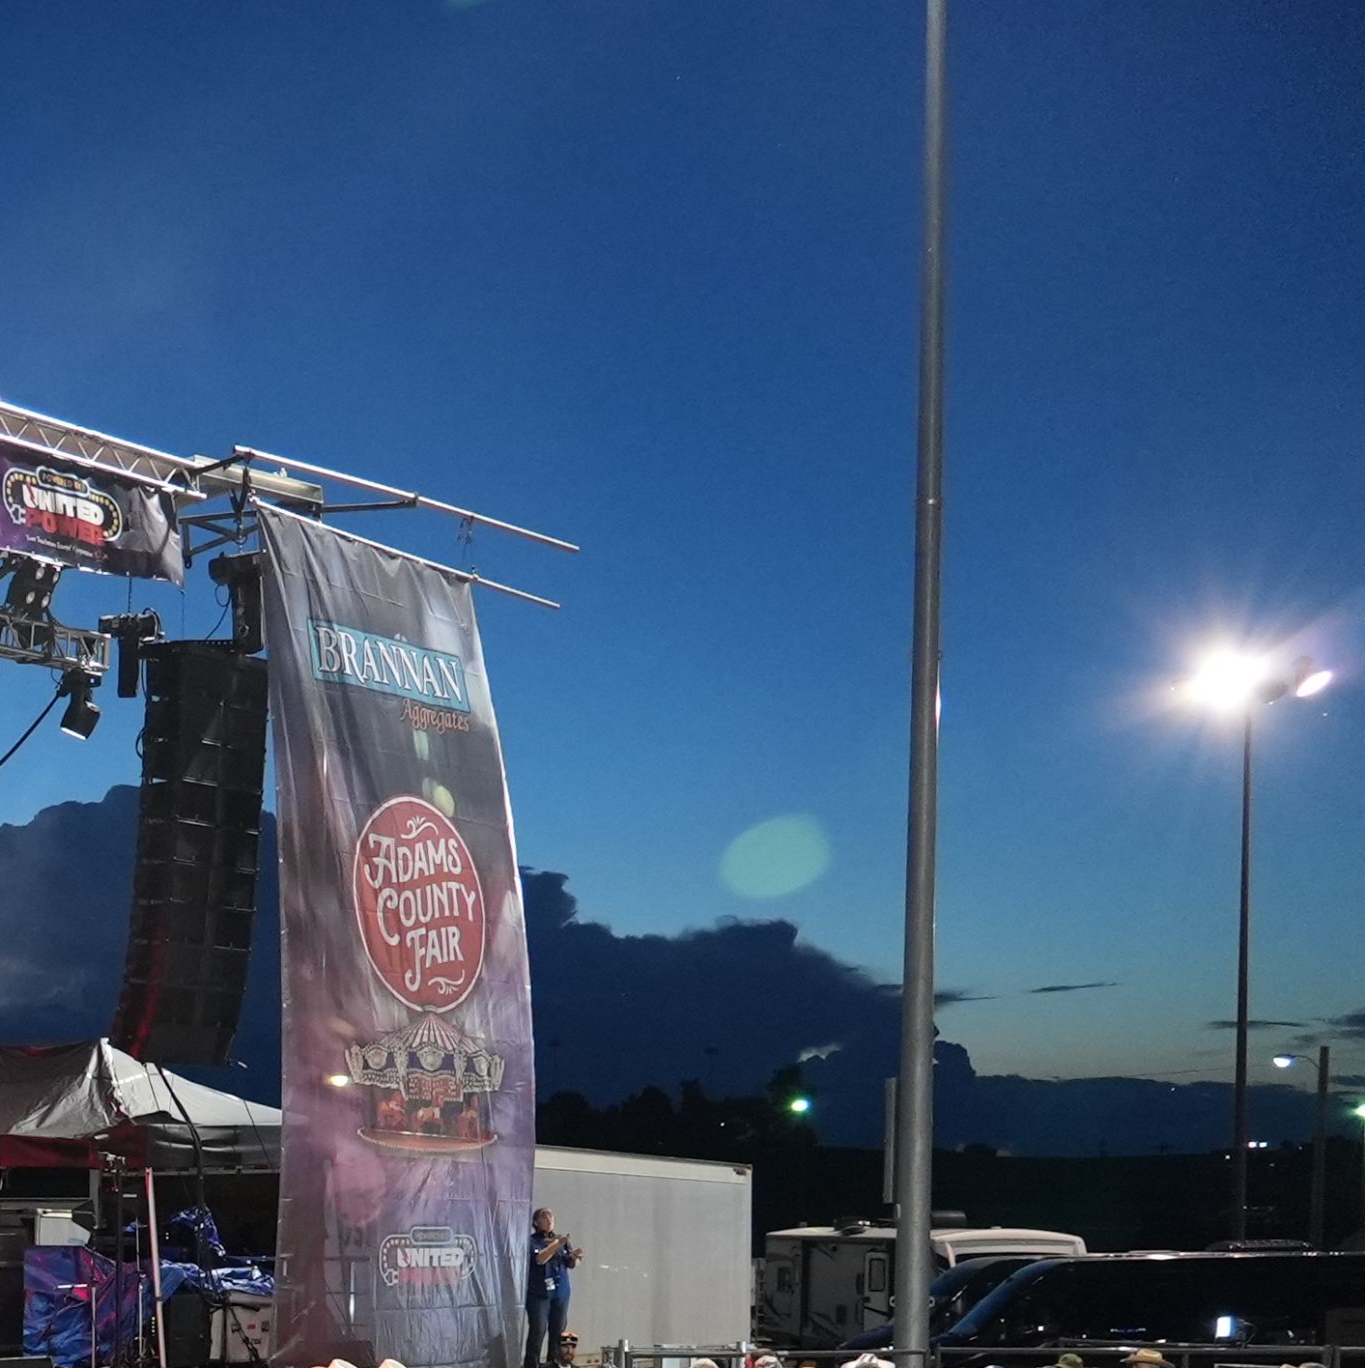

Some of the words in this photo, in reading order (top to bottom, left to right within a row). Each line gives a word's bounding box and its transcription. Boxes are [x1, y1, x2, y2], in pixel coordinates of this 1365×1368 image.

[22, 483, 105, 527] UNITED
[25, 507, 106, 546] POWER
[315, 626, 459, 704] BRANNAN
[400, 697, 470, 736] Aggregates
[364, 832, 463, 889] ADAMS
[376, 881, 477, 946] COUNTY
[404, 925, 465, 992] FAIR
[397, 1247, 465, 1268] UNITED
